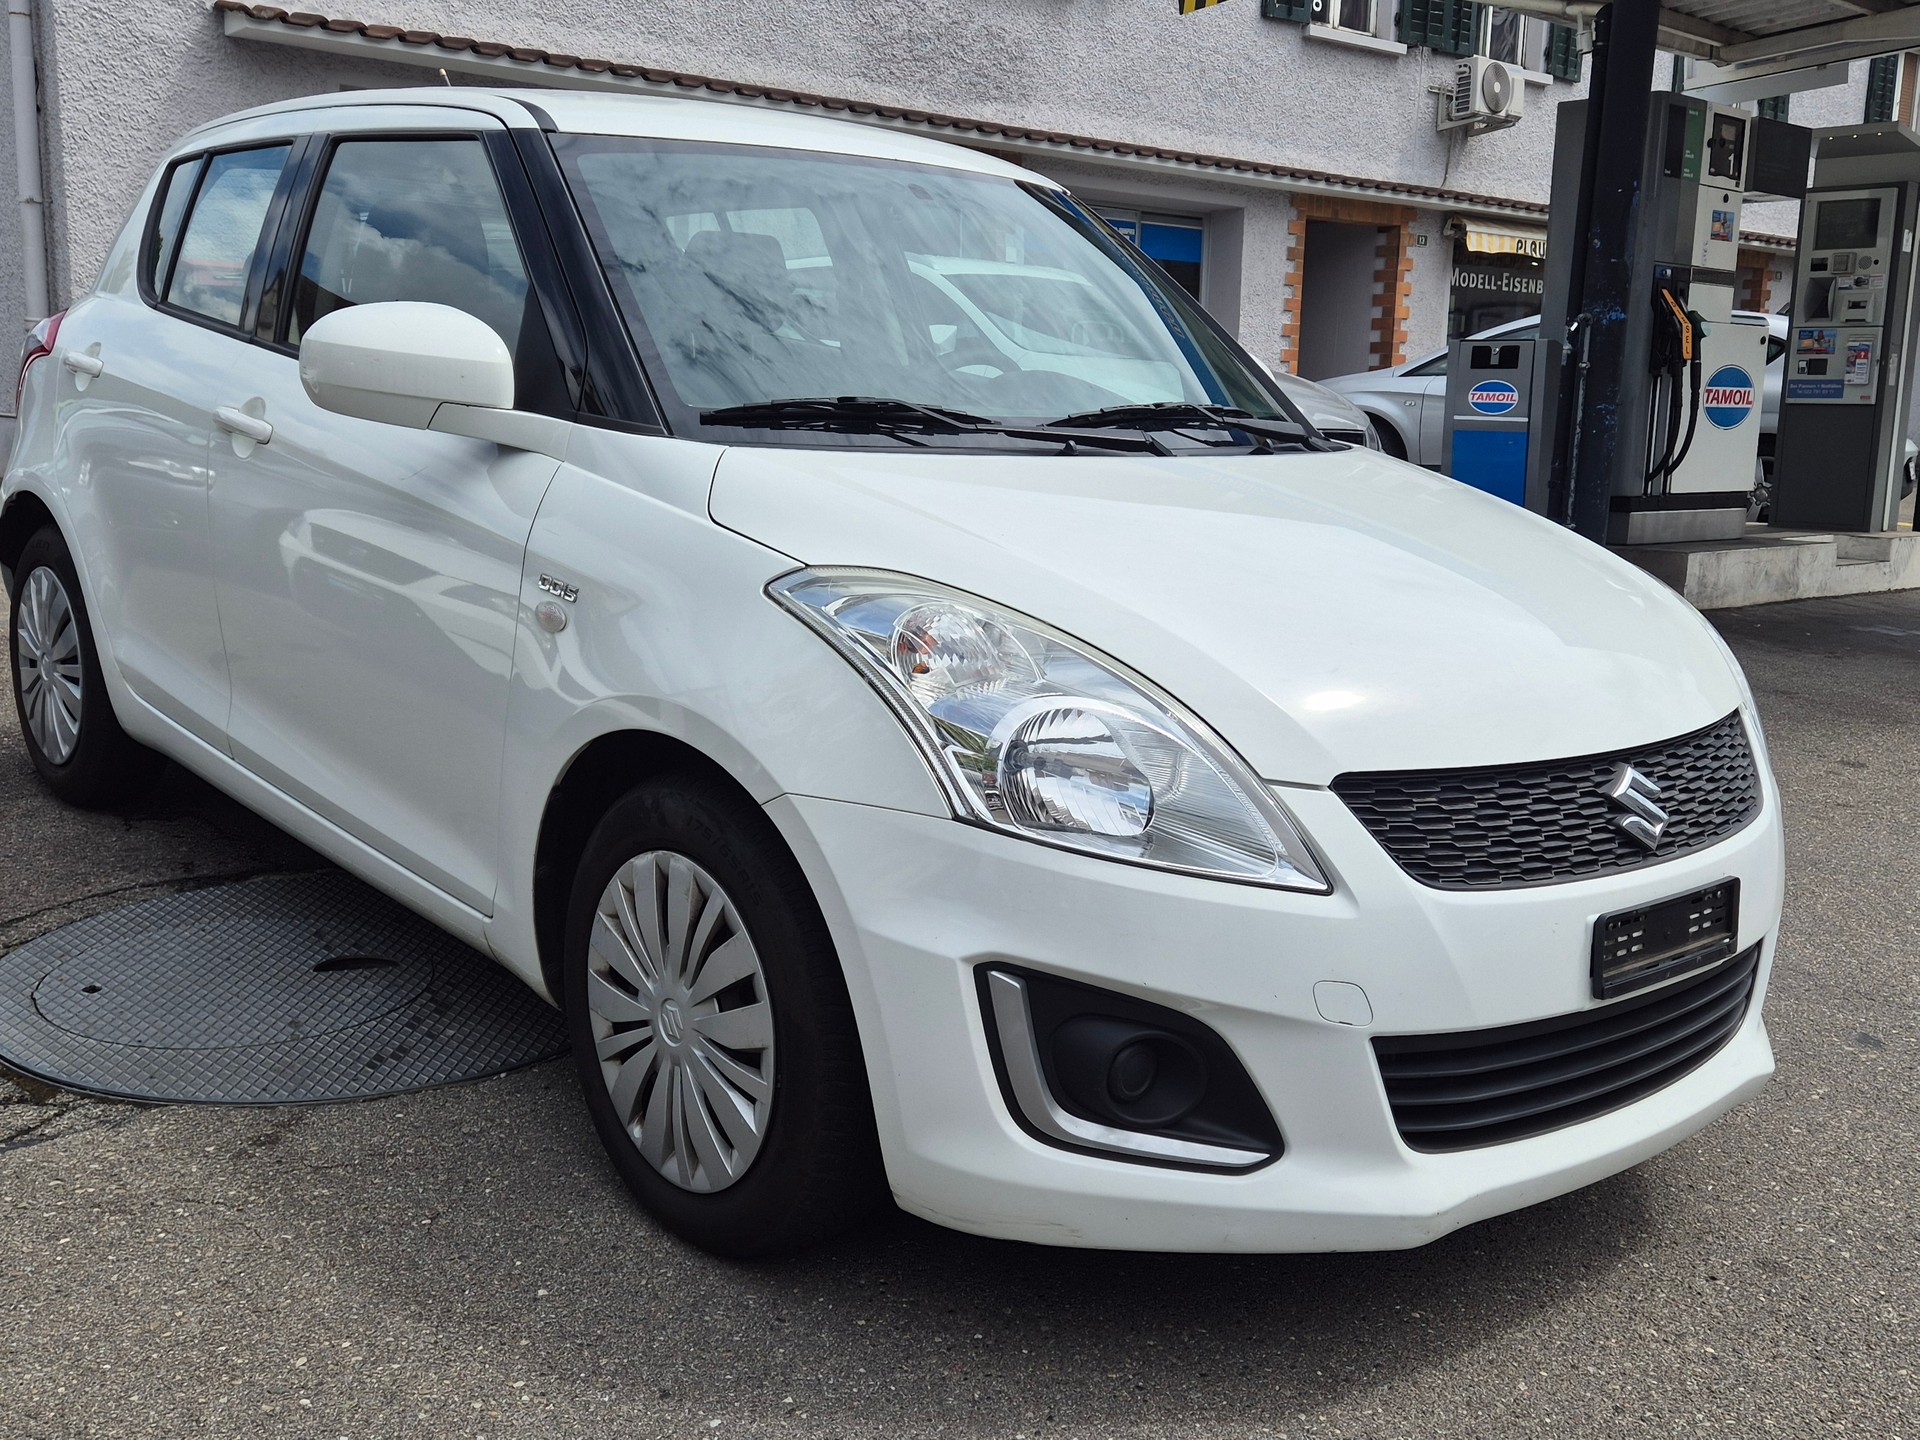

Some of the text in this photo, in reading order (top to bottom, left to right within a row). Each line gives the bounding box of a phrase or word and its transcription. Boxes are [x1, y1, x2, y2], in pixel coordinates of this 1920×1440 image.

[1727, 152, 1735, 175] 1
[1470, 392, 1516, 402] TAMOIL
[1704, 388, 1753, 409] TAMOIL
